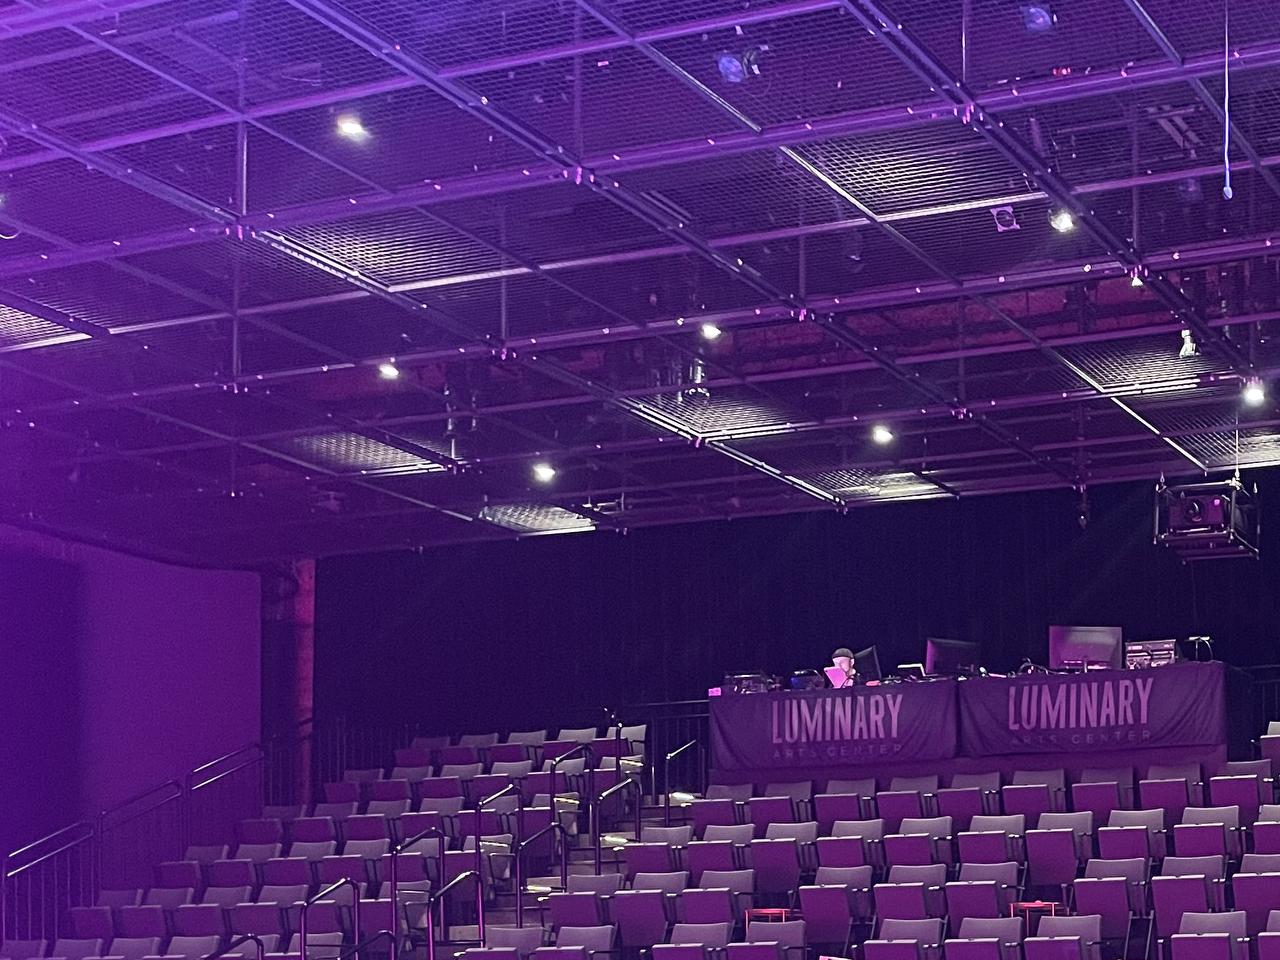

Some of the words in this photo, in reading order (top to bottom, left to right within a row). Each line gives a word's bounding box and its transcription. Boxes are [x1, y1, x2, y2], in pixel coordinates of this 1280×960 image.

[772, 693, 903, 744] LUMINARY
[1008, 677, 1154, 730] LUMINARY
[773, 748, 817, 759] ARTS
[826, 743, 903, 758] CENTER
[1010, 734, 1057, 745] ARTS
[1071, 729, 1152, 745] CENTER
